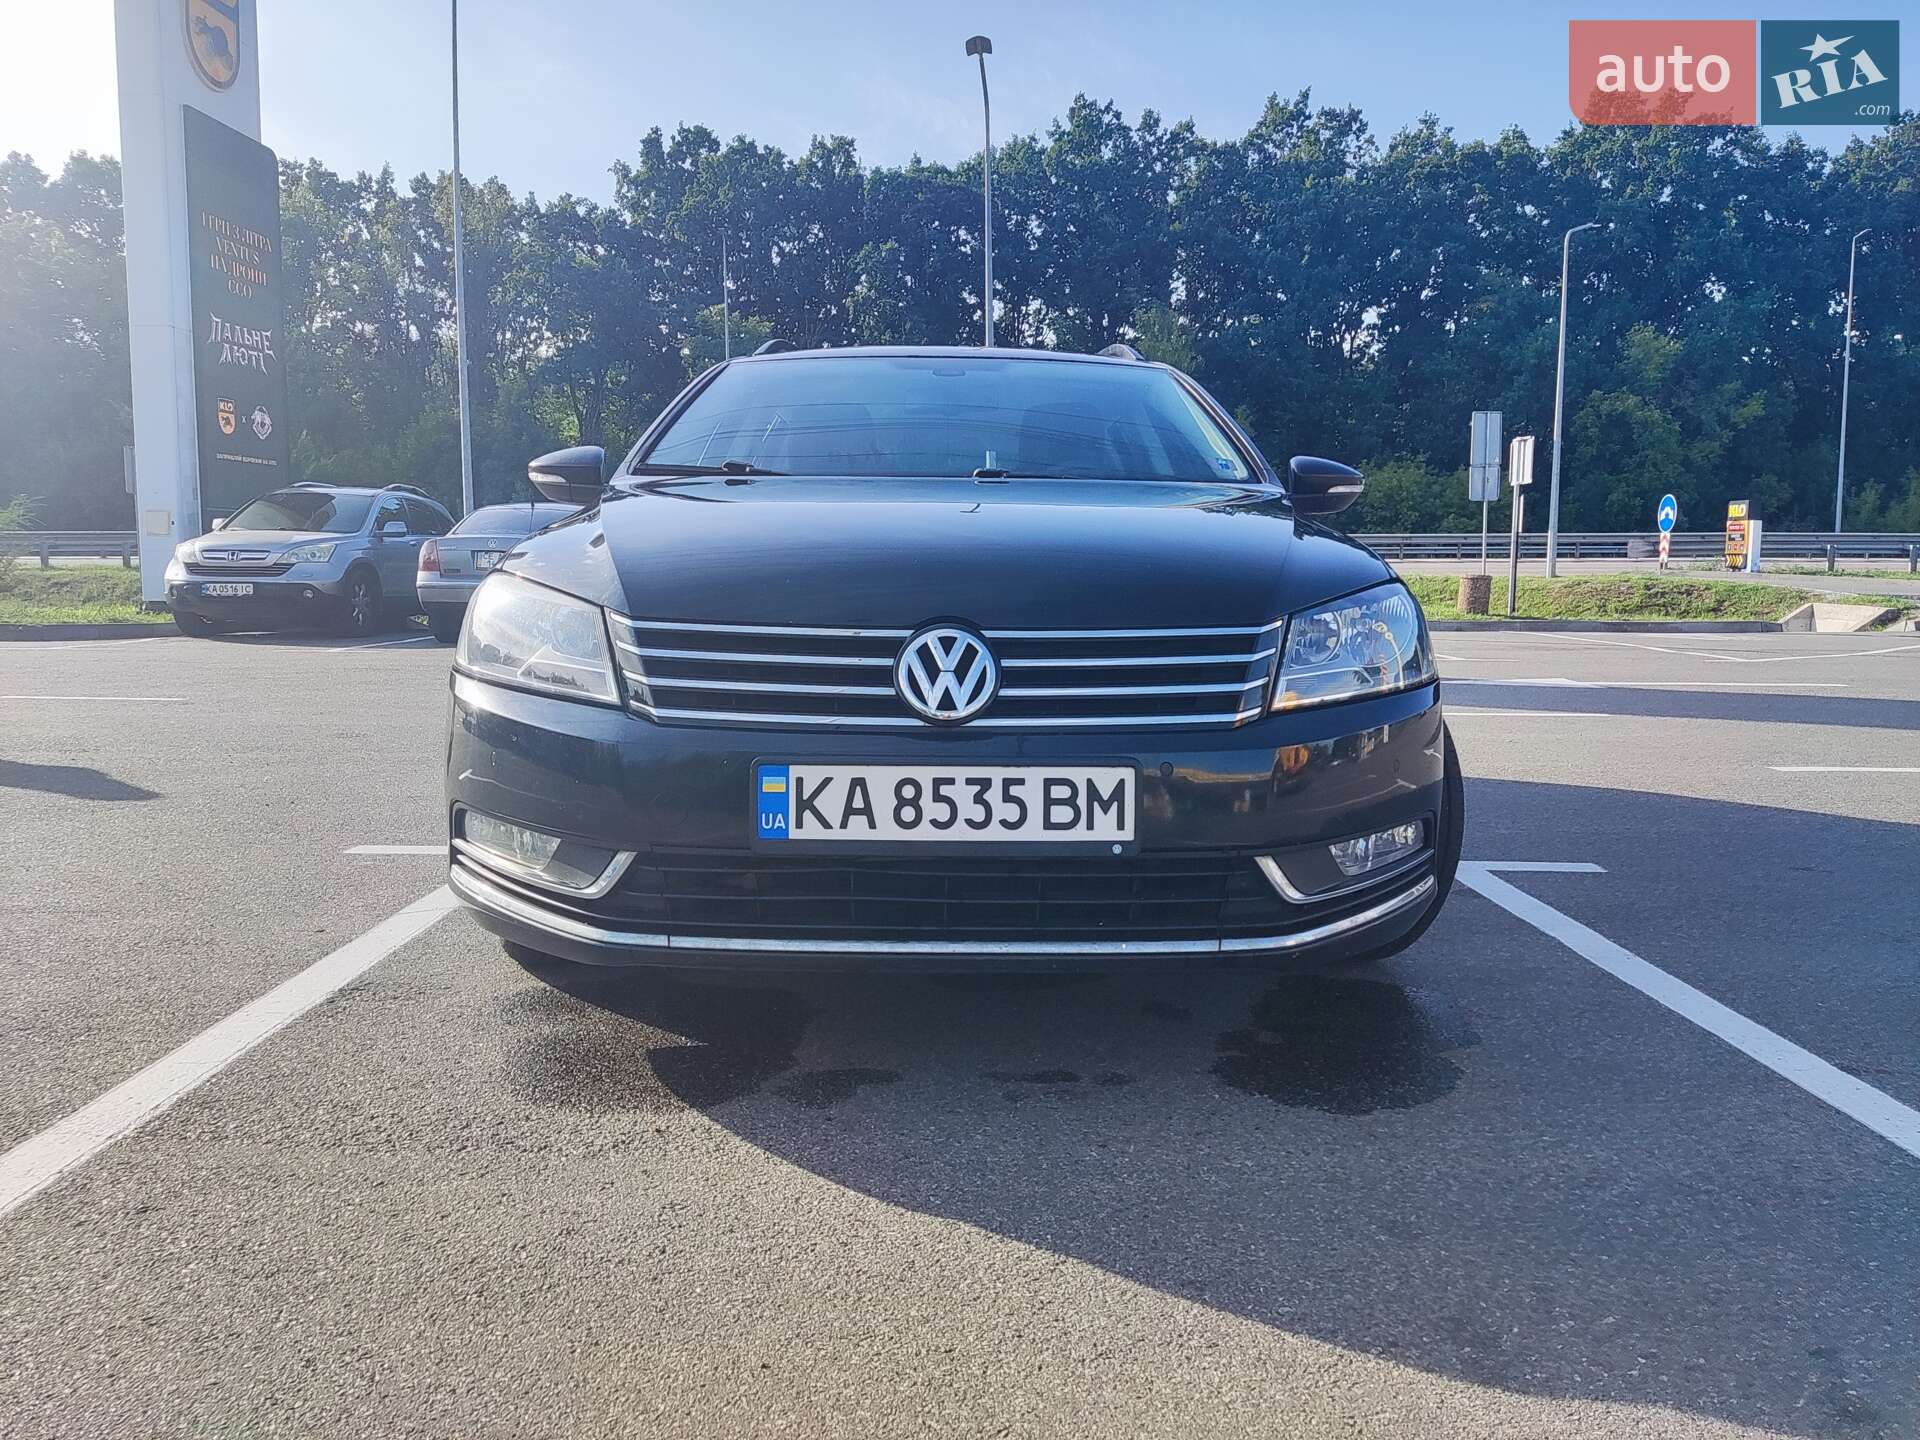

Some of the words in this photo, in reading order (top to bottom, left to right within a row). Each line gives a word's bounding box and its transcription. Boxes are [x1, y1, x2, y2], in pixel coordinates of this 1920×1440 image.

[207, 311, 277, 362] ПАЛЬНЕ
[218, 343, 269, 377] ЛЮТІ
[207, 584, 218, 594] KA
[241, 584, 252, 594] IC
[794, 776, 877, 830] KA
[892, 777, 1028, 831] 8535
[1042, 777, 1125, 831] BM
[761, 813, 786, 830] UA
